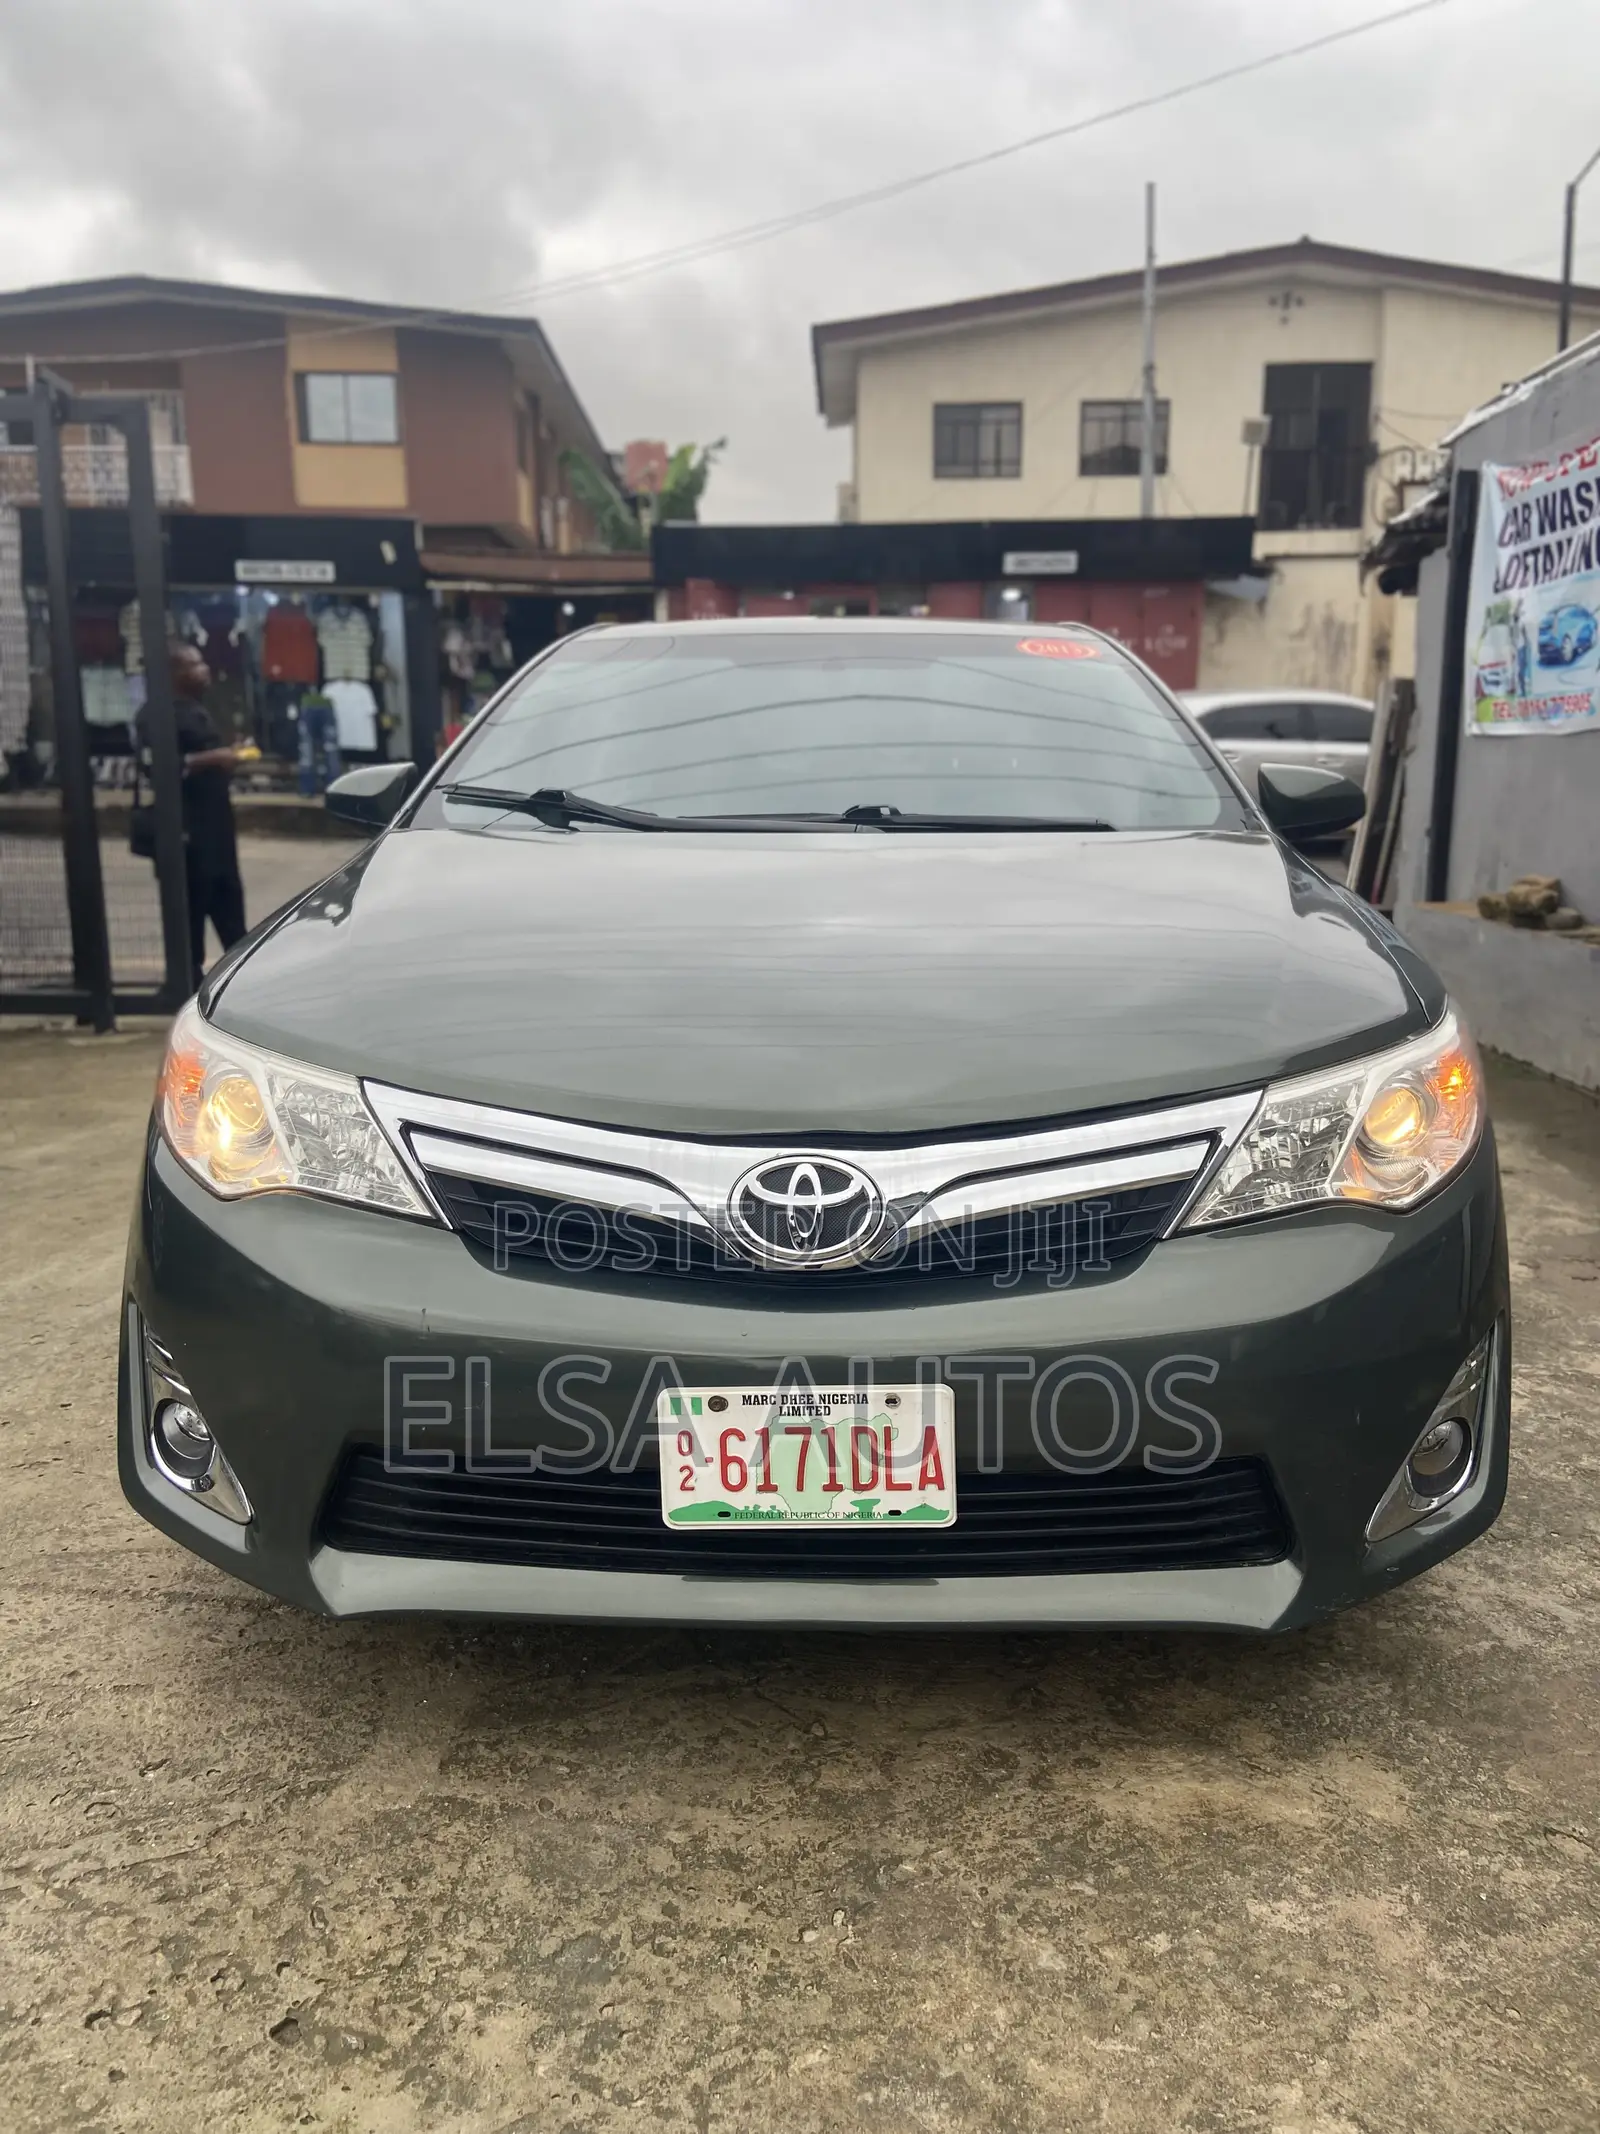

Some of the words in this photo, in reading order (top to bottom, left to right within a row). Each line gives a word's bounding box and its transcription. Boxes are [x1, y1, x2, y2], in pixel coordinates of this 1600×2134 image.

[1498, 502, 1532, 548] CAR
[741, 1394, 777, 1406] MARC
[780, 1394, 815, 1406] DHEE
[818, 1393, 869, 1405] NIGERIA
[778, 1405, 831, 1417] LIMITED
[734, 1511, 779, 1520] FEDERAL
[778, 1511, 826, 1519] REPUBLIC
[827, 1511, 841, 1519] OF
[842, 1511, 883, 1519] NIGERIA
